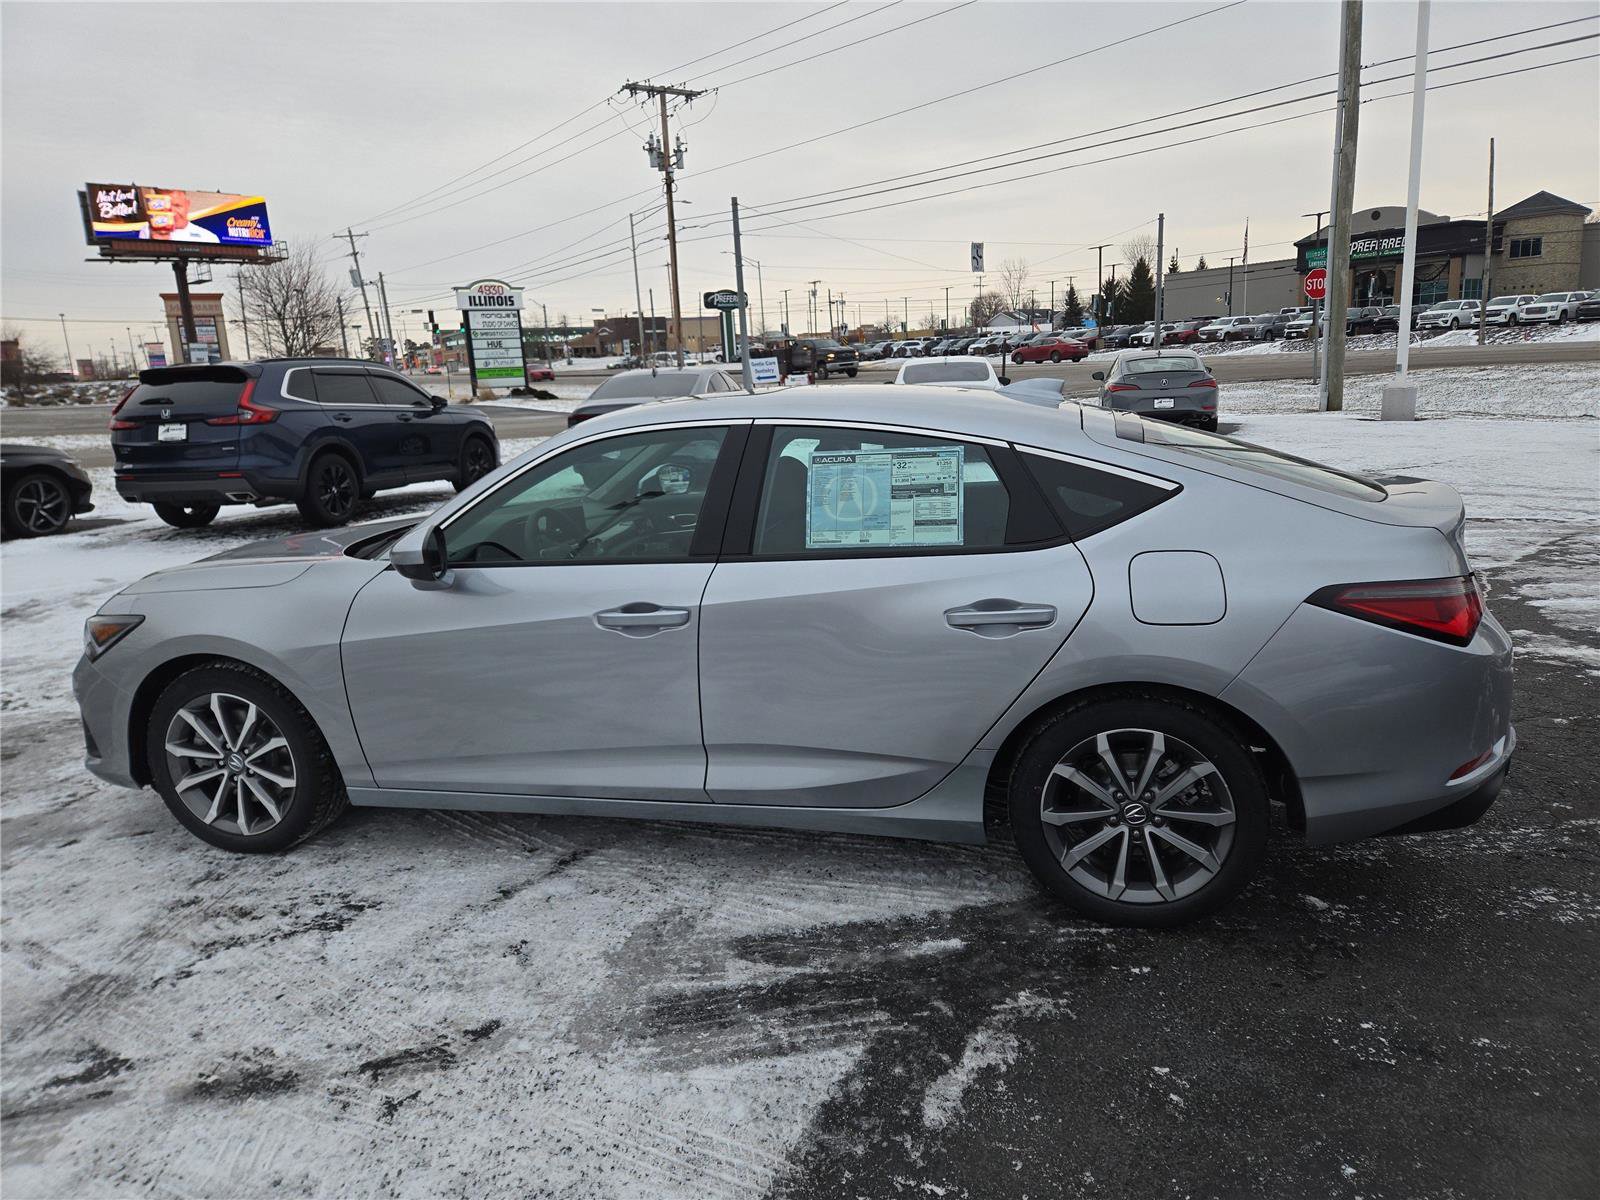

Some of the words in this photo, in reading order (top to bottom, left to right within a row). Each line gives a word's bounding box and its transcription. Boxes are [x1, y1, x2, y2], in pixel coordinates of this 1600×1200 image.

[227, 216, 258, 229] Creamy
[477, 284, 505, 296] 4930
[486, 340, 504, 348] HUE
[896, 461, 908, 470] 32
